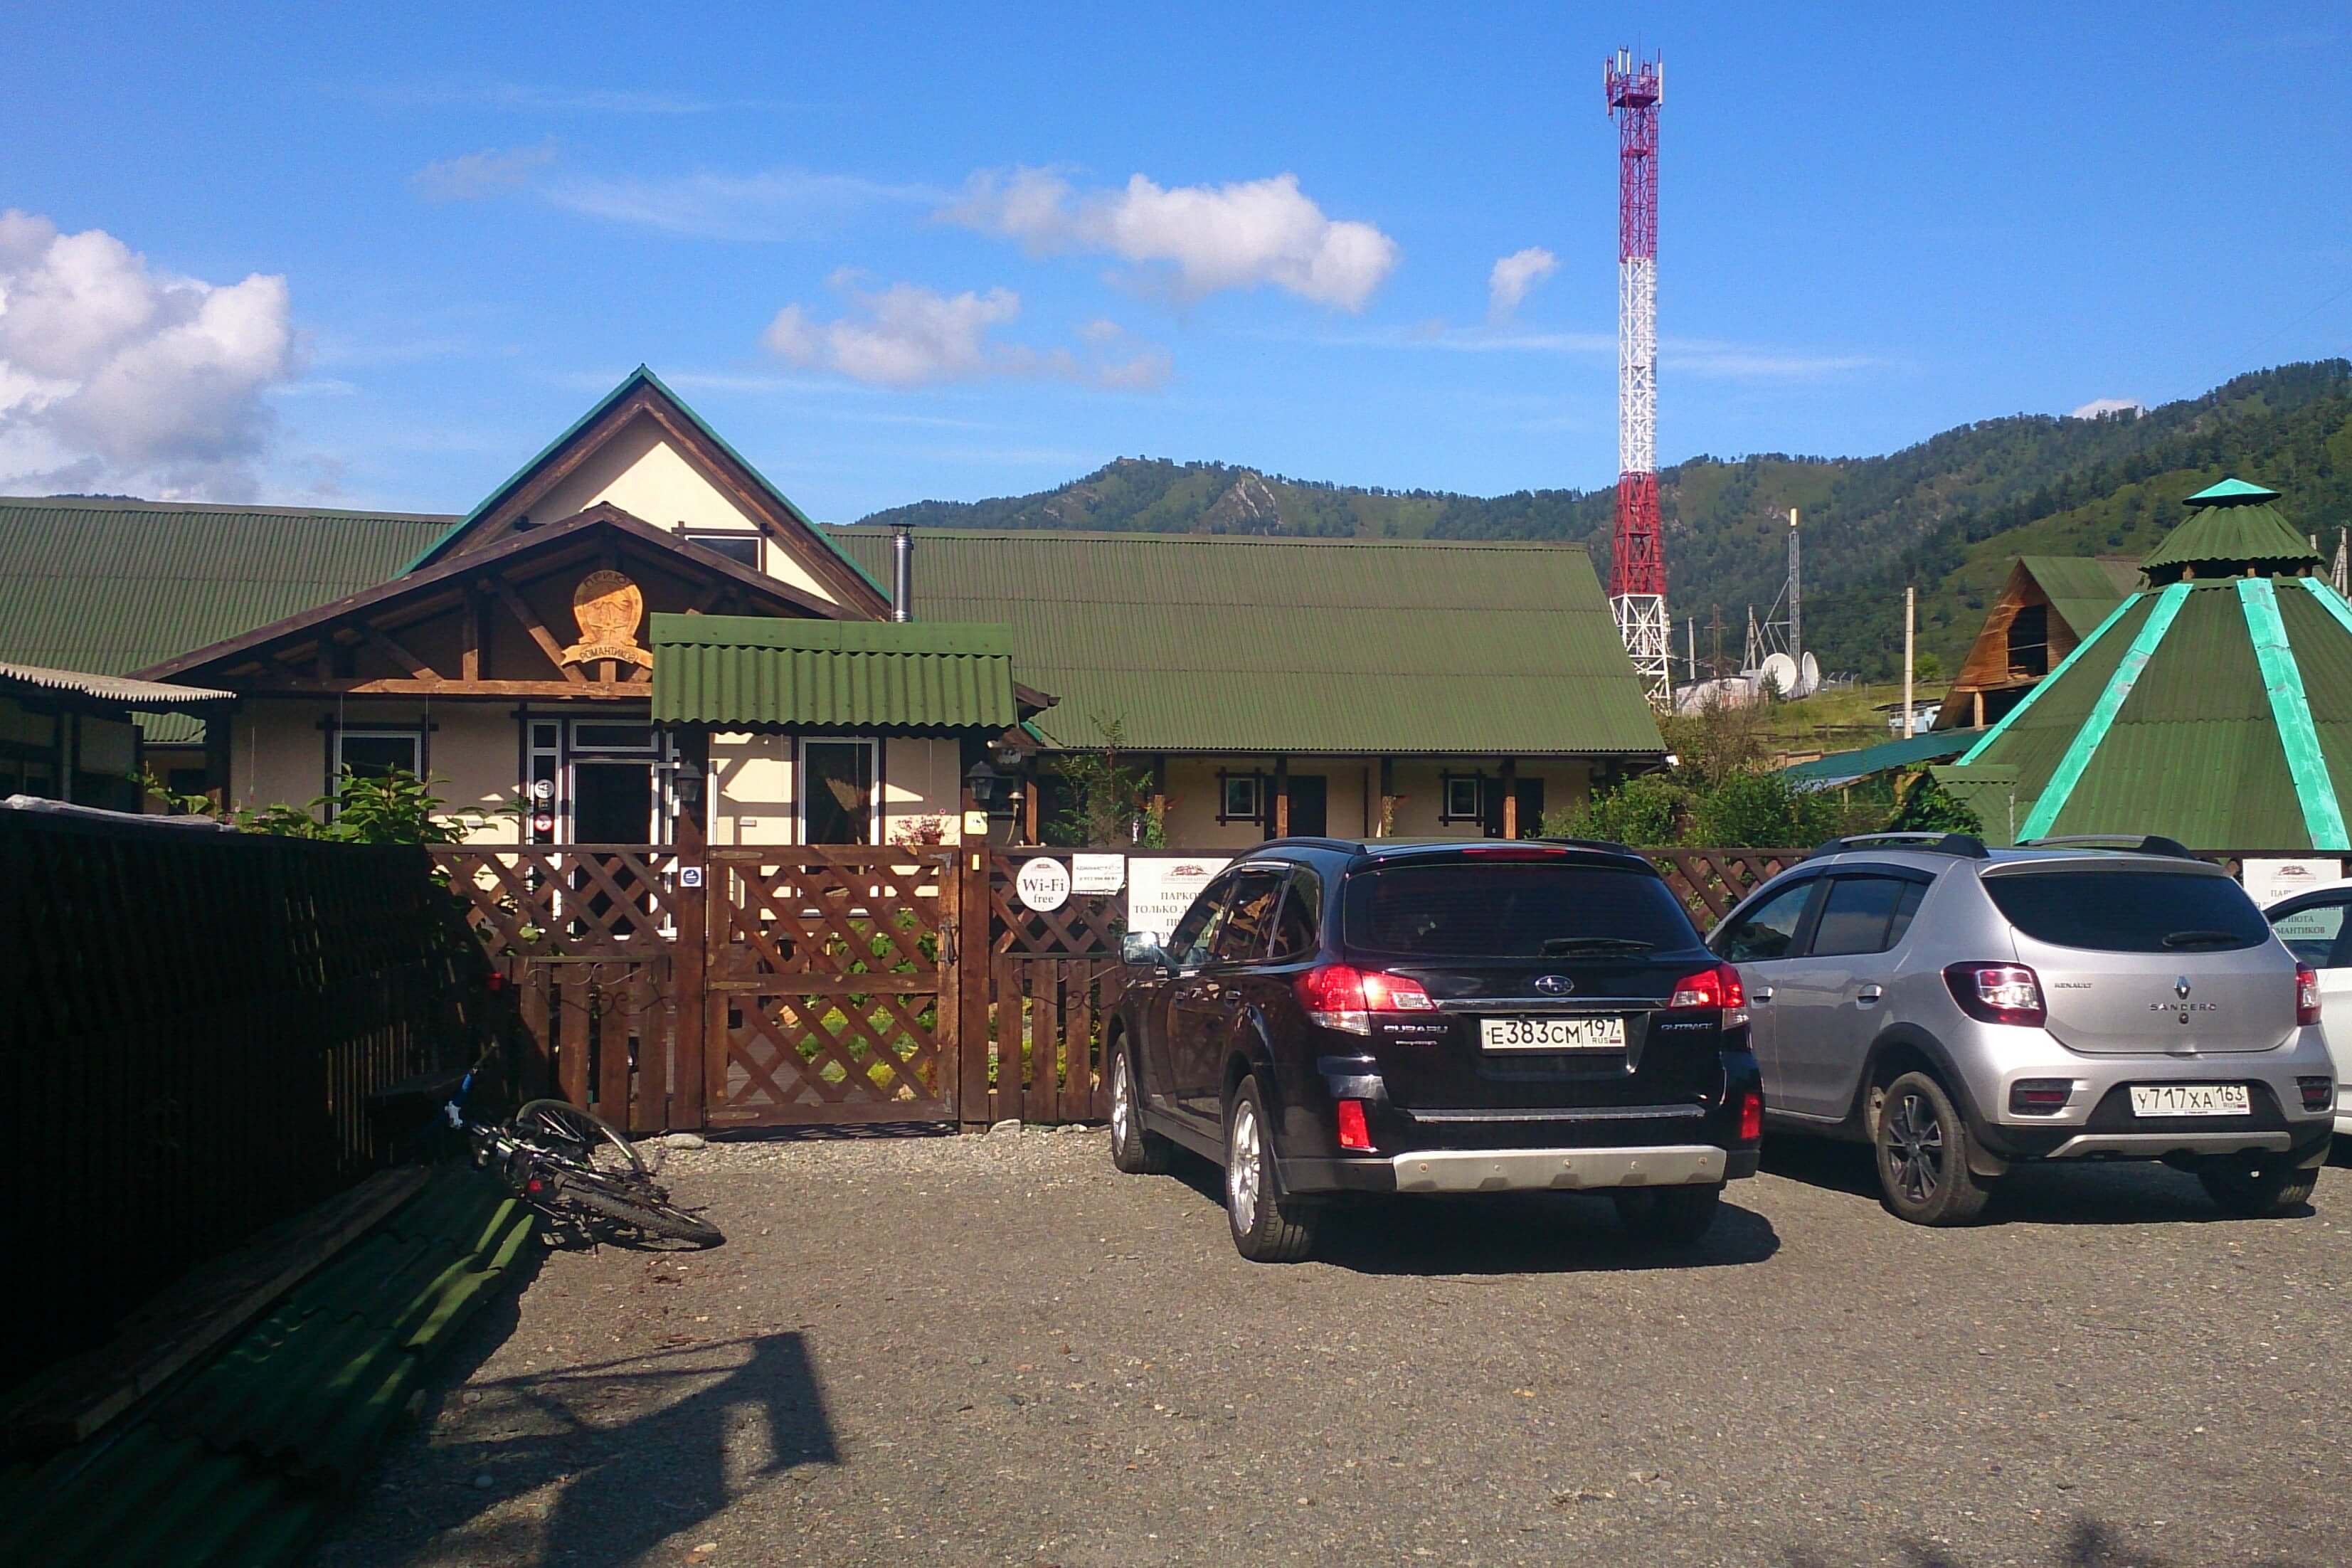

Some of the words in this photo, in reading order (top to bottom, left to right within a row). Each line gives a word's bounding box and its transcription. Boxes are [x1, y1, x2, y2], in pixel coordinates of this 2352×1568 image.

[1022, 878, 1064, 891] Wi-Fi
[1034, 894, 1054, 904] free
[1133, 905, 1177, 914] ТОЛЬКО
[1584, 1020, 1616, 1038] 197
[2216, 1086, 2242, 1102] 163
